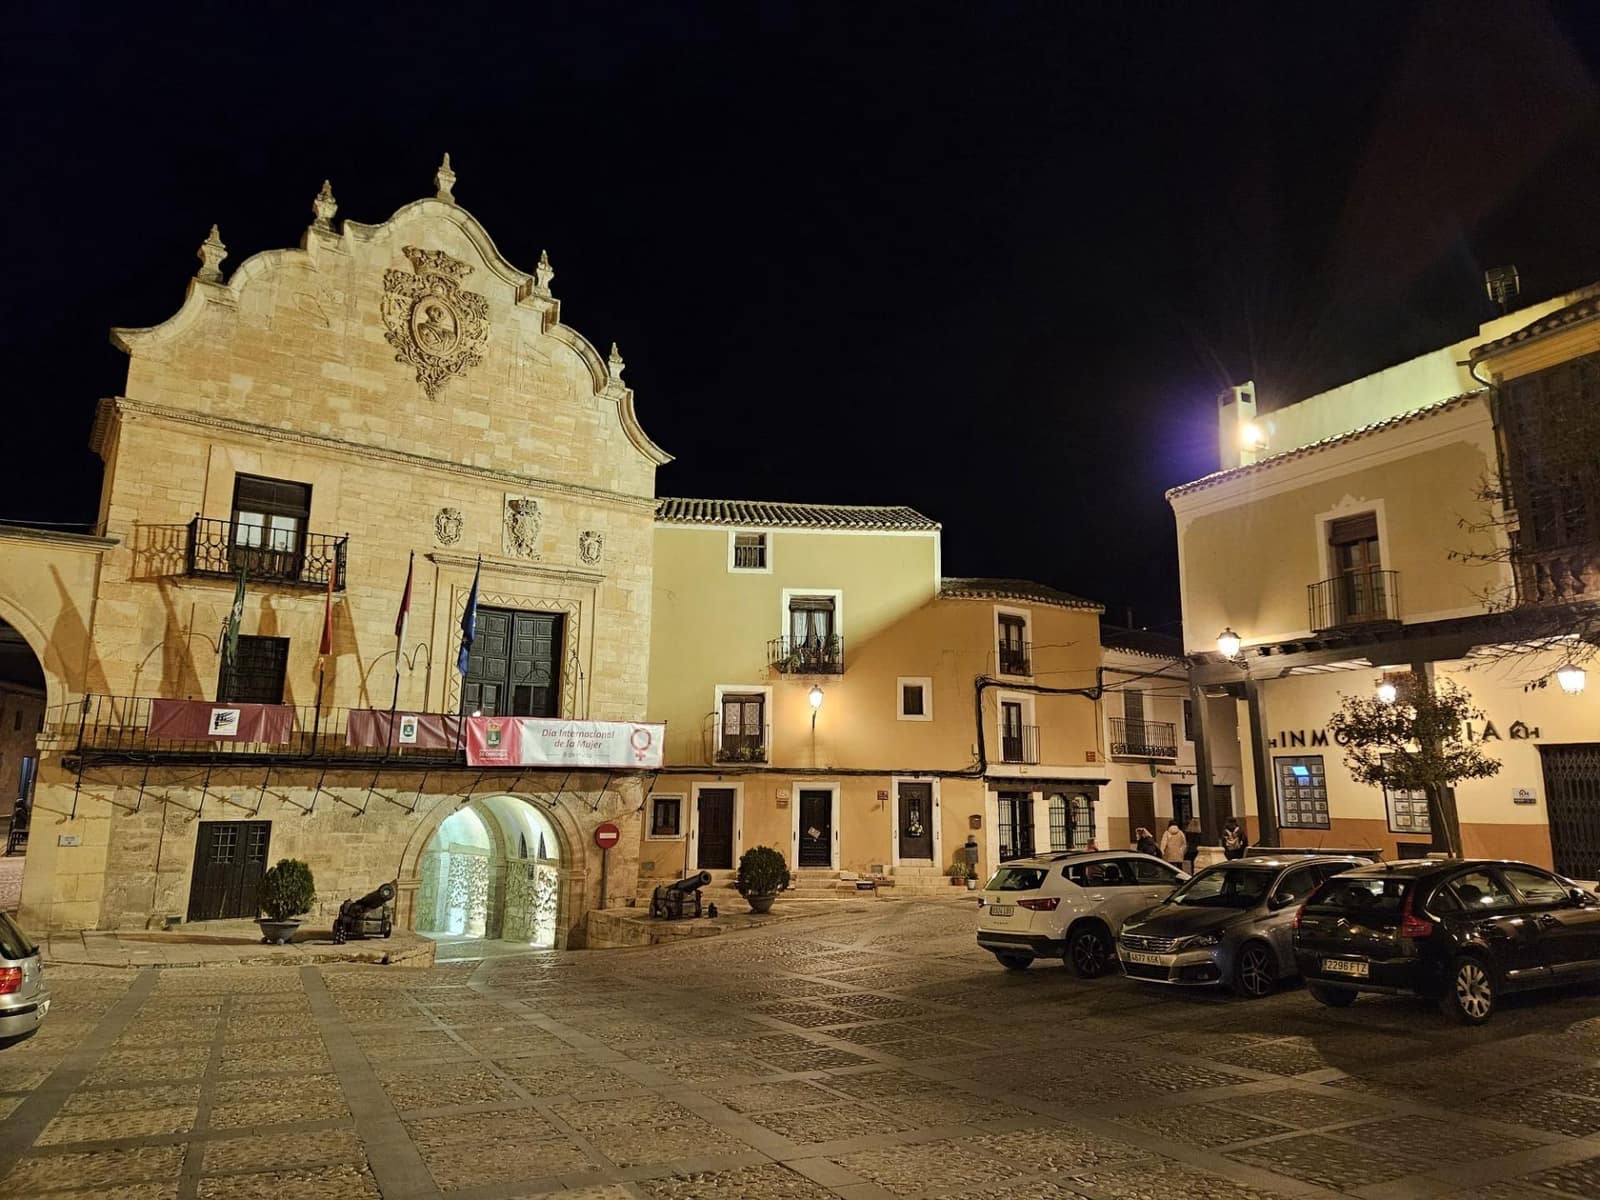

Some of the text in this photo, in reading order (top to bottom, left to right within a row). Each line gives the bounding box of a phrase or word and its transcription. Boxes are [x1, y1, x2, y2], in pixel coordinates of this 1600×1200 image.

[559, 729, 615, 739] Internacional
[1280, 720, 1503, 748] INMOIA
[554, 740, 602, 750] de la Mujer
[1327, 960, 1349, 971] 2296
